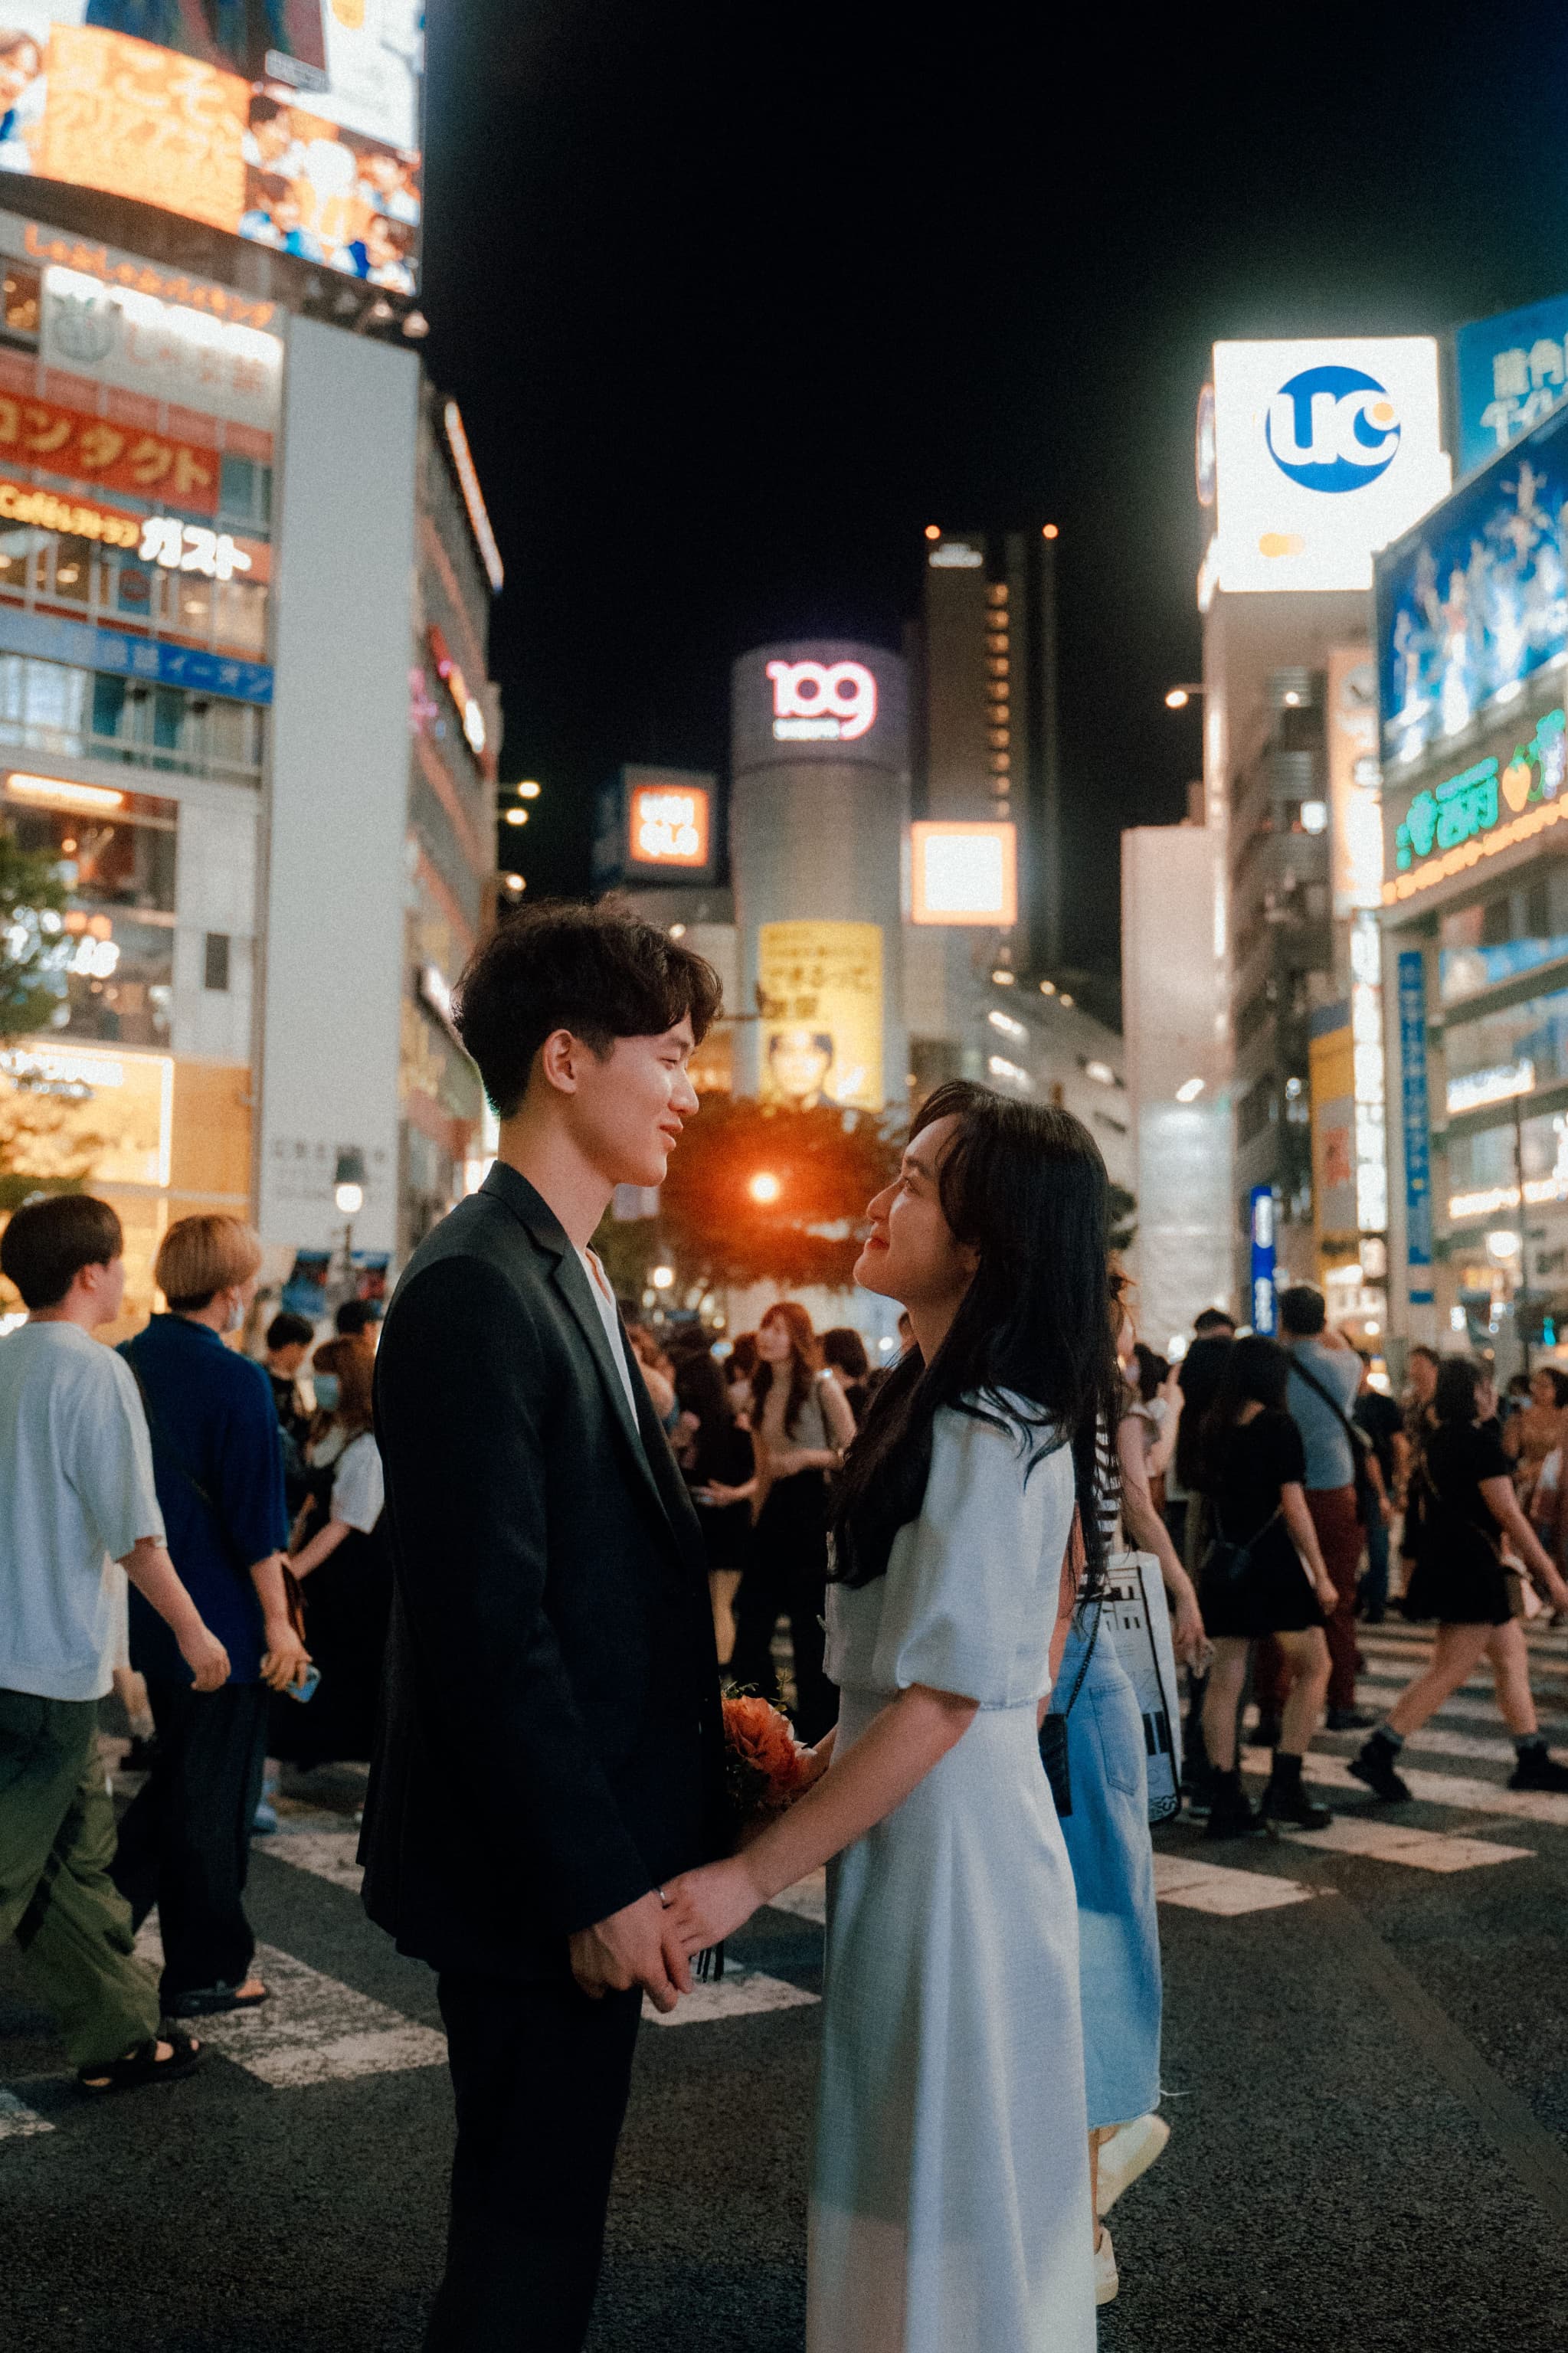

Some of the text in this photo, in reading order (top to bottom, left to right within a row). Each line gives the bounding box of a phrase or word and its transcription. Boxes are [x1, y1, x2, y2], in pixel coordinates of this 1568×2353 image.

[138, 516, 252, 581] ガスト
[767, 661, 876, 739] 109
